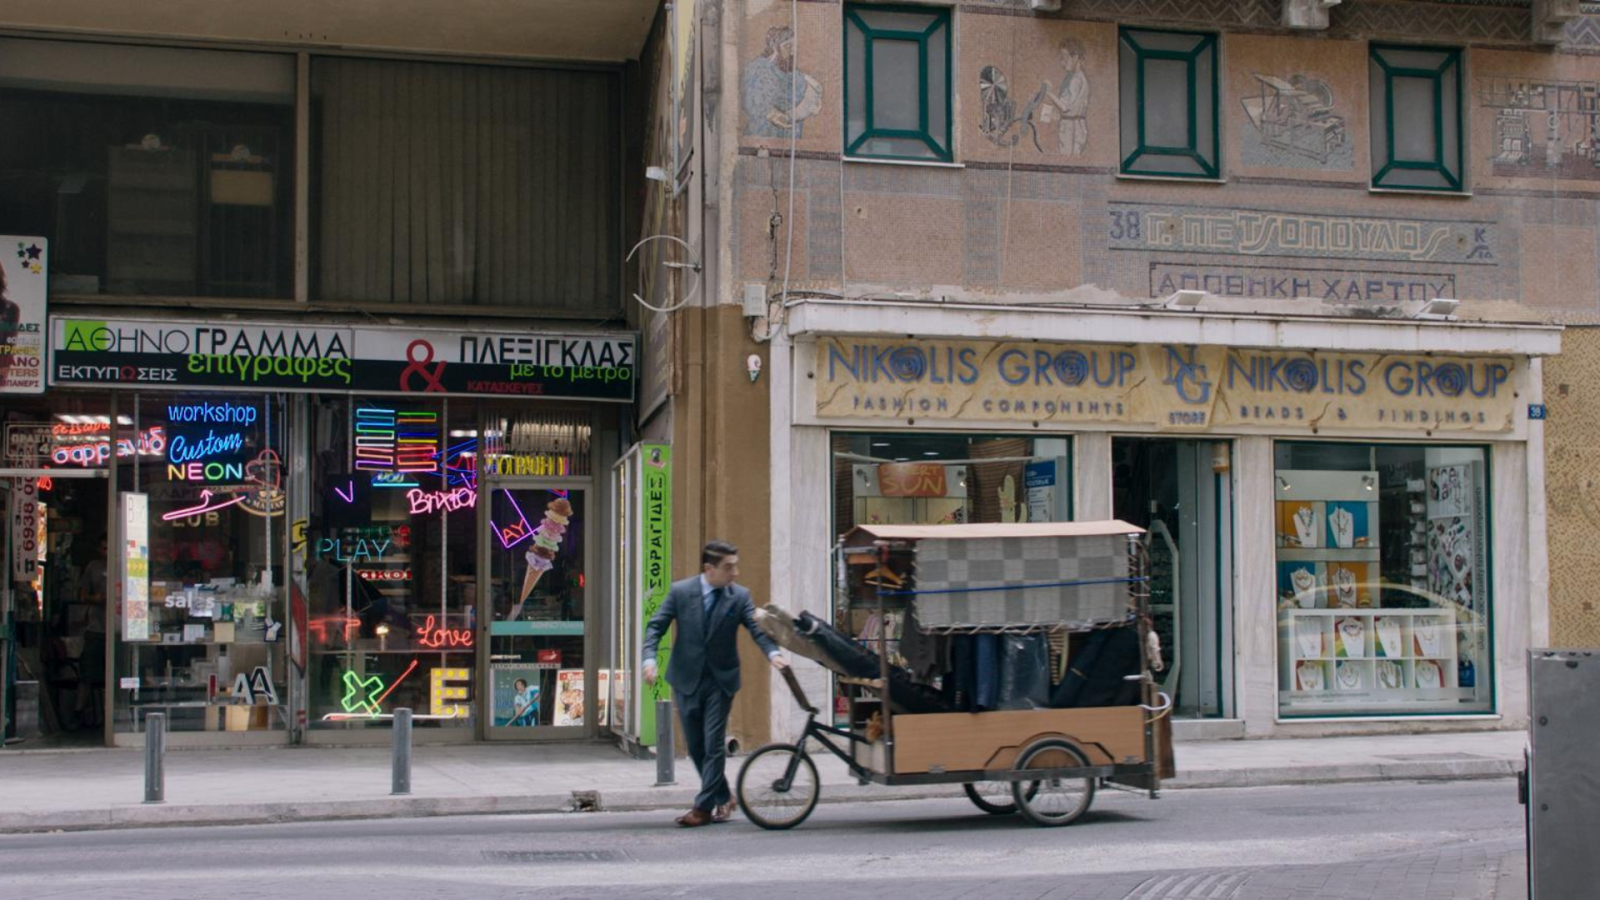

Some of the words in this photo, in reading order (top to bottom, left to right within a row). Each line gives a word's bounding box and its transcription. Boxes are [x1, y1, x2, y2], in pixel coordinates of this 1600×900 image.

[1109, 211, 1141, 240] 38
[1158, 272, 1311, 298] ΑΠΟΘΗΚΗ
[1323, 278, 1448, 301] ΧΑΡΤΟΥ
[58, 364, 178, 381] ΕΚΤΥΠΩΣΕΙΣ
[400, 339, 448, 394] &
[460, 336, 634, 368] ΠΛΕΞΙΓΚΛΑΣ
[510, 362, 535, 381] με
[543, 365, 564, 379] το
[828, 344, 980, 385] NIKOLIS
[998, 349, 1136, 388] GROUP
[1227, 354, 1367, 396] NIKOLIS
[1385, 361, 1509, 399] GROUP
[168, 402, 256, 427] workshop
[852, 395, 948, 412] FASHION
[983, 399, 1124, 416] COMPONENTS
[1168, 411, 1206, 425] STORE
[1240, 405, 1304, 420] BEADS
[1378, 409, 1486, 424] FINDINGS
[170, 429, 242, 463] Custom
[168, 462, 242, 480] NEON
[883, 476, 943, 496] SUN
[23, 502, 35, 552] 6938
[650, 476, 663, 590] ΣΦΡΑΓΙΔΕΣ
[316, 538, 391, 562] PLAY
[416, 614, 474, 648] Love
